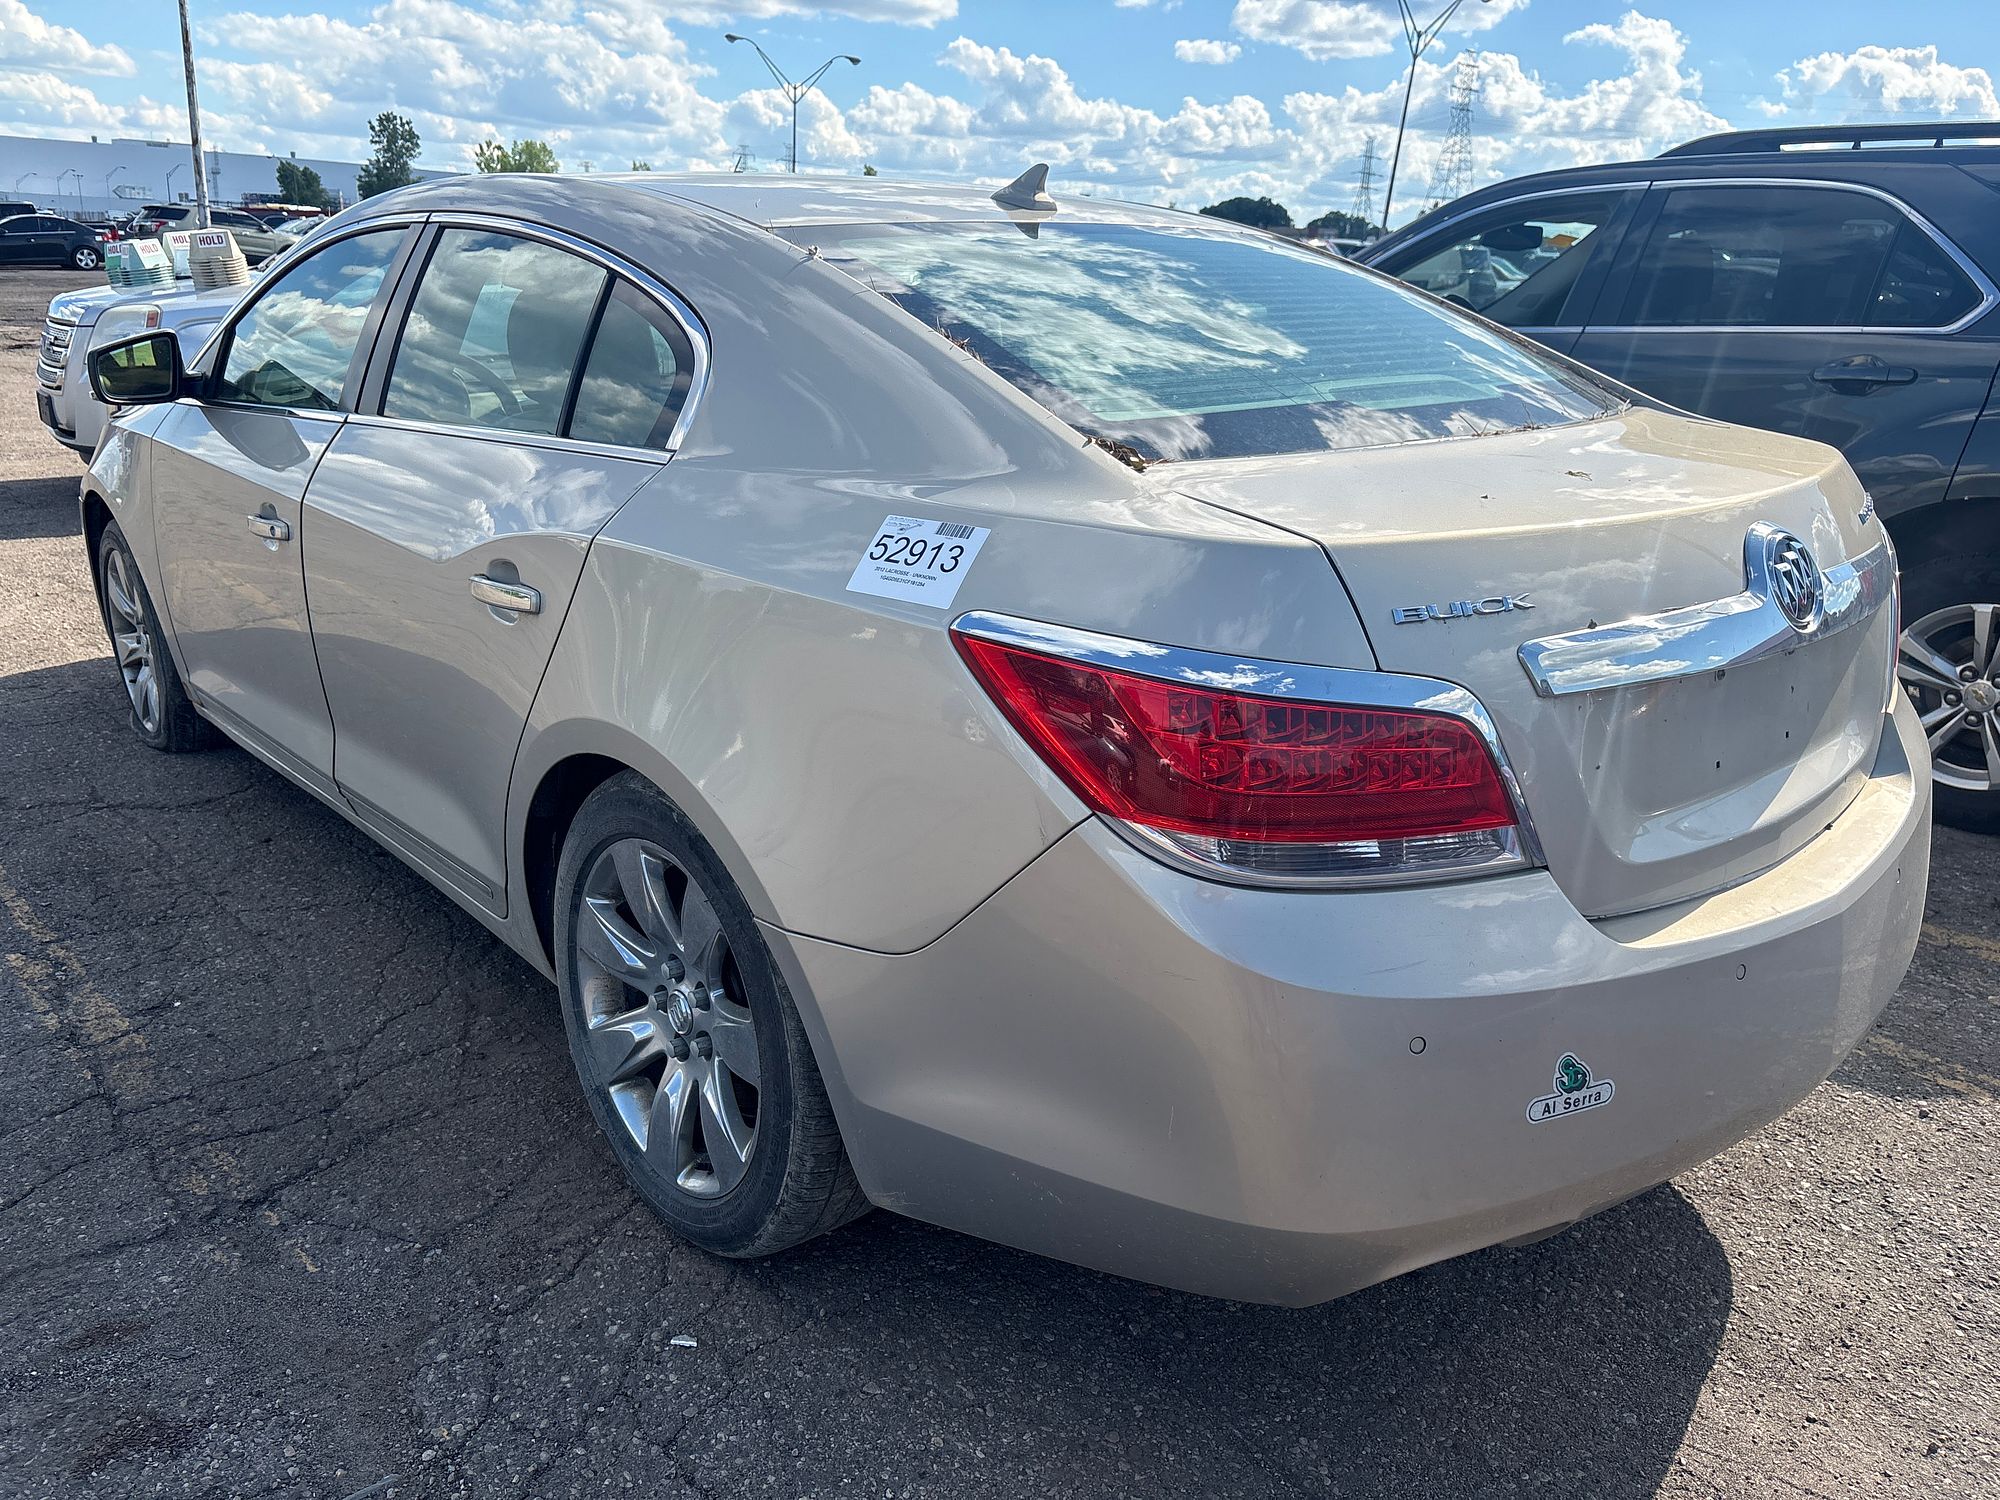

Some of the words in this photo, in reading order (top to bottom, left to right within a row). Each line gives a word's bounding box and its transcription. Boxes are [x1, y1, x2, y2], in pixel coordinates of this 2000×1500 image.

[172, 234, 190, 244] HOL
[198, 235, 224, 246] HOLD
[140, 244, 159, 254] HOLD
[869, 534, 965, 573] 52913
[884, 567, 910, 576] LACROSSE
[912, 572, 937, 581] UNKNOWN
[1391, 592, 1537, 626] BUICK
[1542, 1102, 1556, 1117] Al
[1563, 1091, 1602, 1110] Serra
